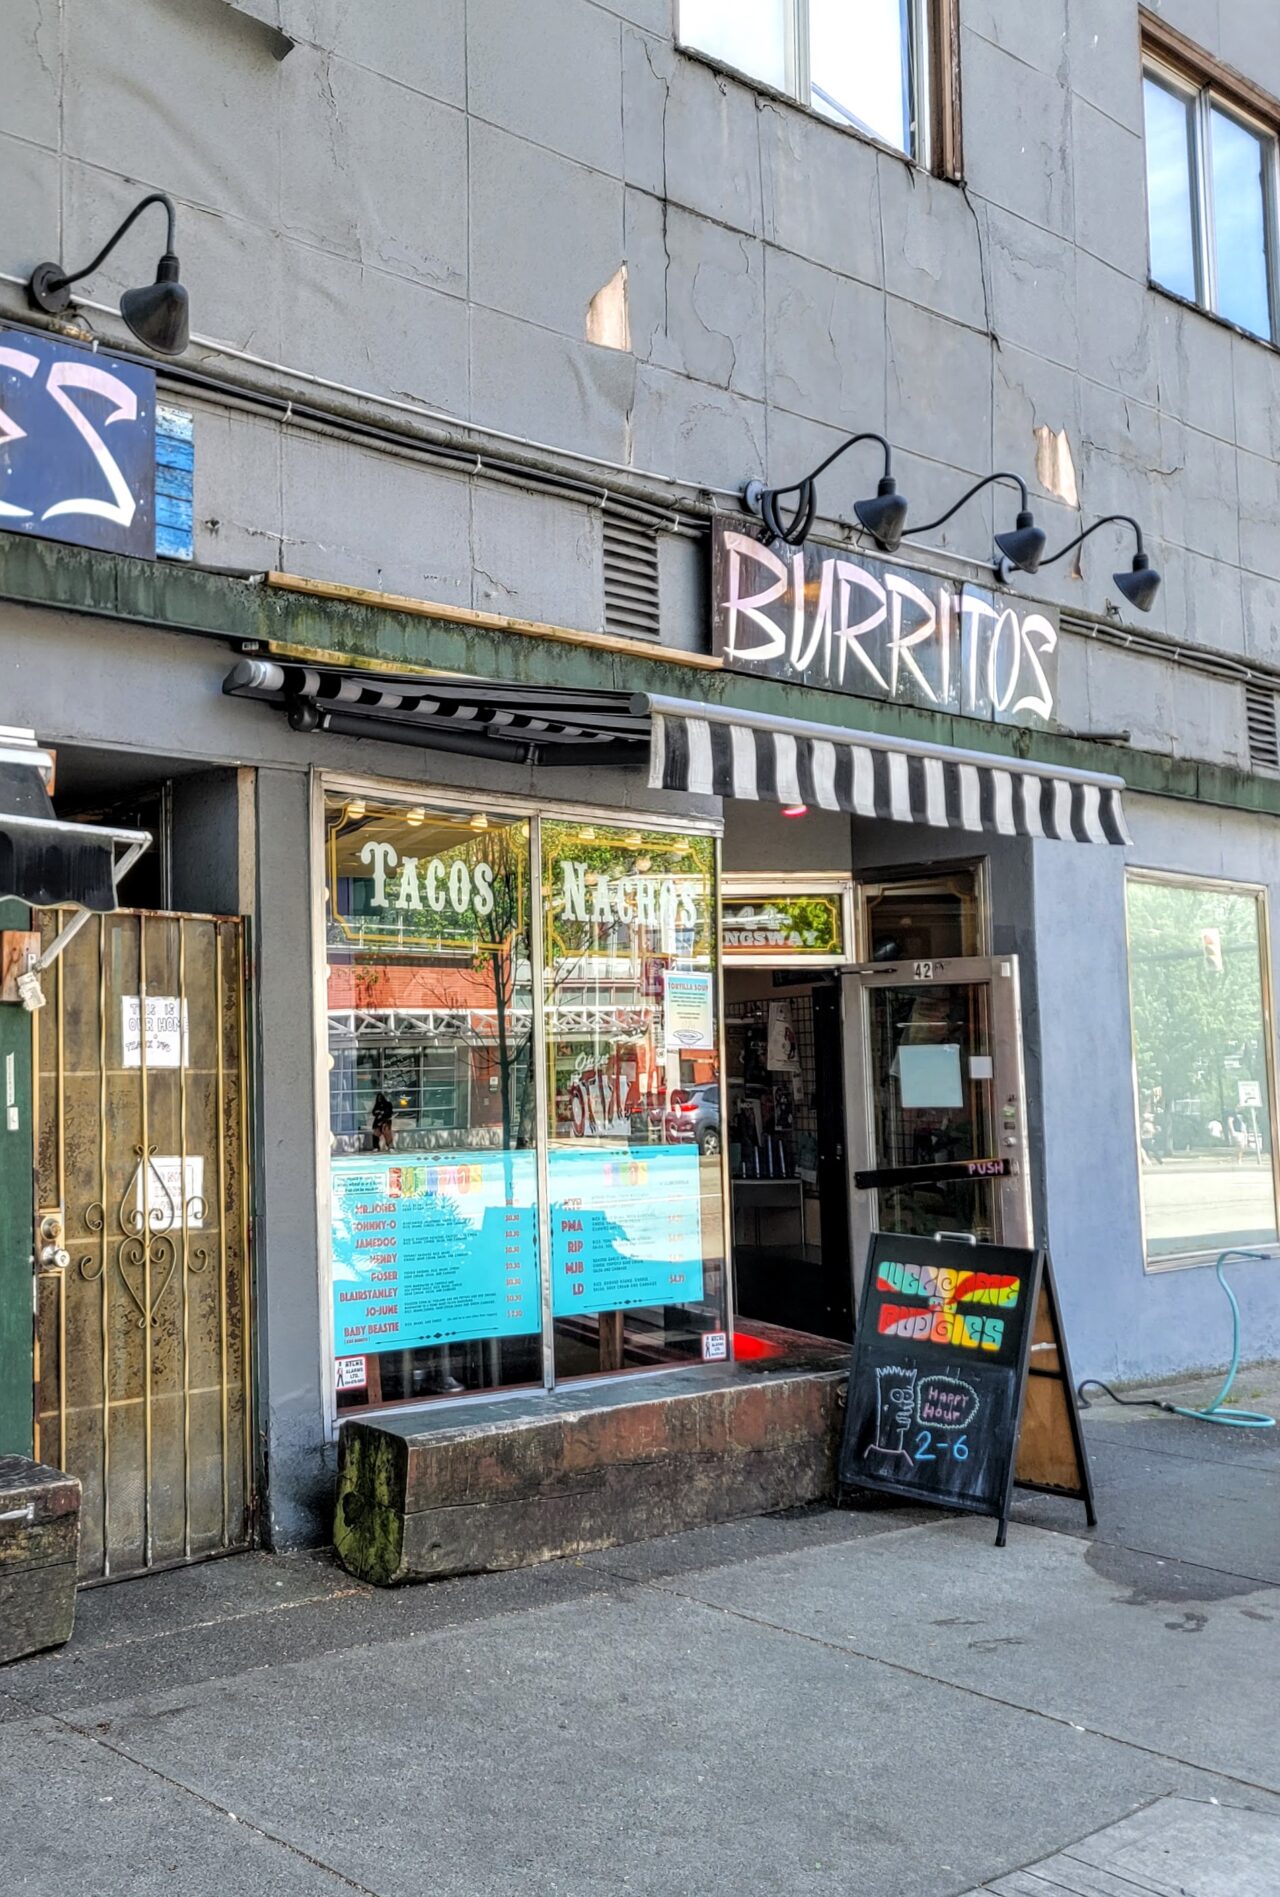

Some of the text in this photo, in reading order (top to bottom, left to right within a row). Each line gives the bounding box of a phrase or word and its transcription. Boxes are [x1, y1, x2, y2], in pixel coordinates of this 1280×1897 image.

[721, 530, 1057, 720] BURRITOS
[360, 840, 494, 915] TACOS
[560, 860, 697, 929] NACHOS
[722, 930, 819, 946] NGSWAY
[130, 1003, 156, 1016] TIS
[968, 1161, 1004, 1175] PUSH
[561, 1221, 583, 1232] PMA
[567, 1241, 583, 1253] RIP
[572, 1284, 584, 1296] LD
[344, 1322, 399, 1337] BABY BEASTIE
